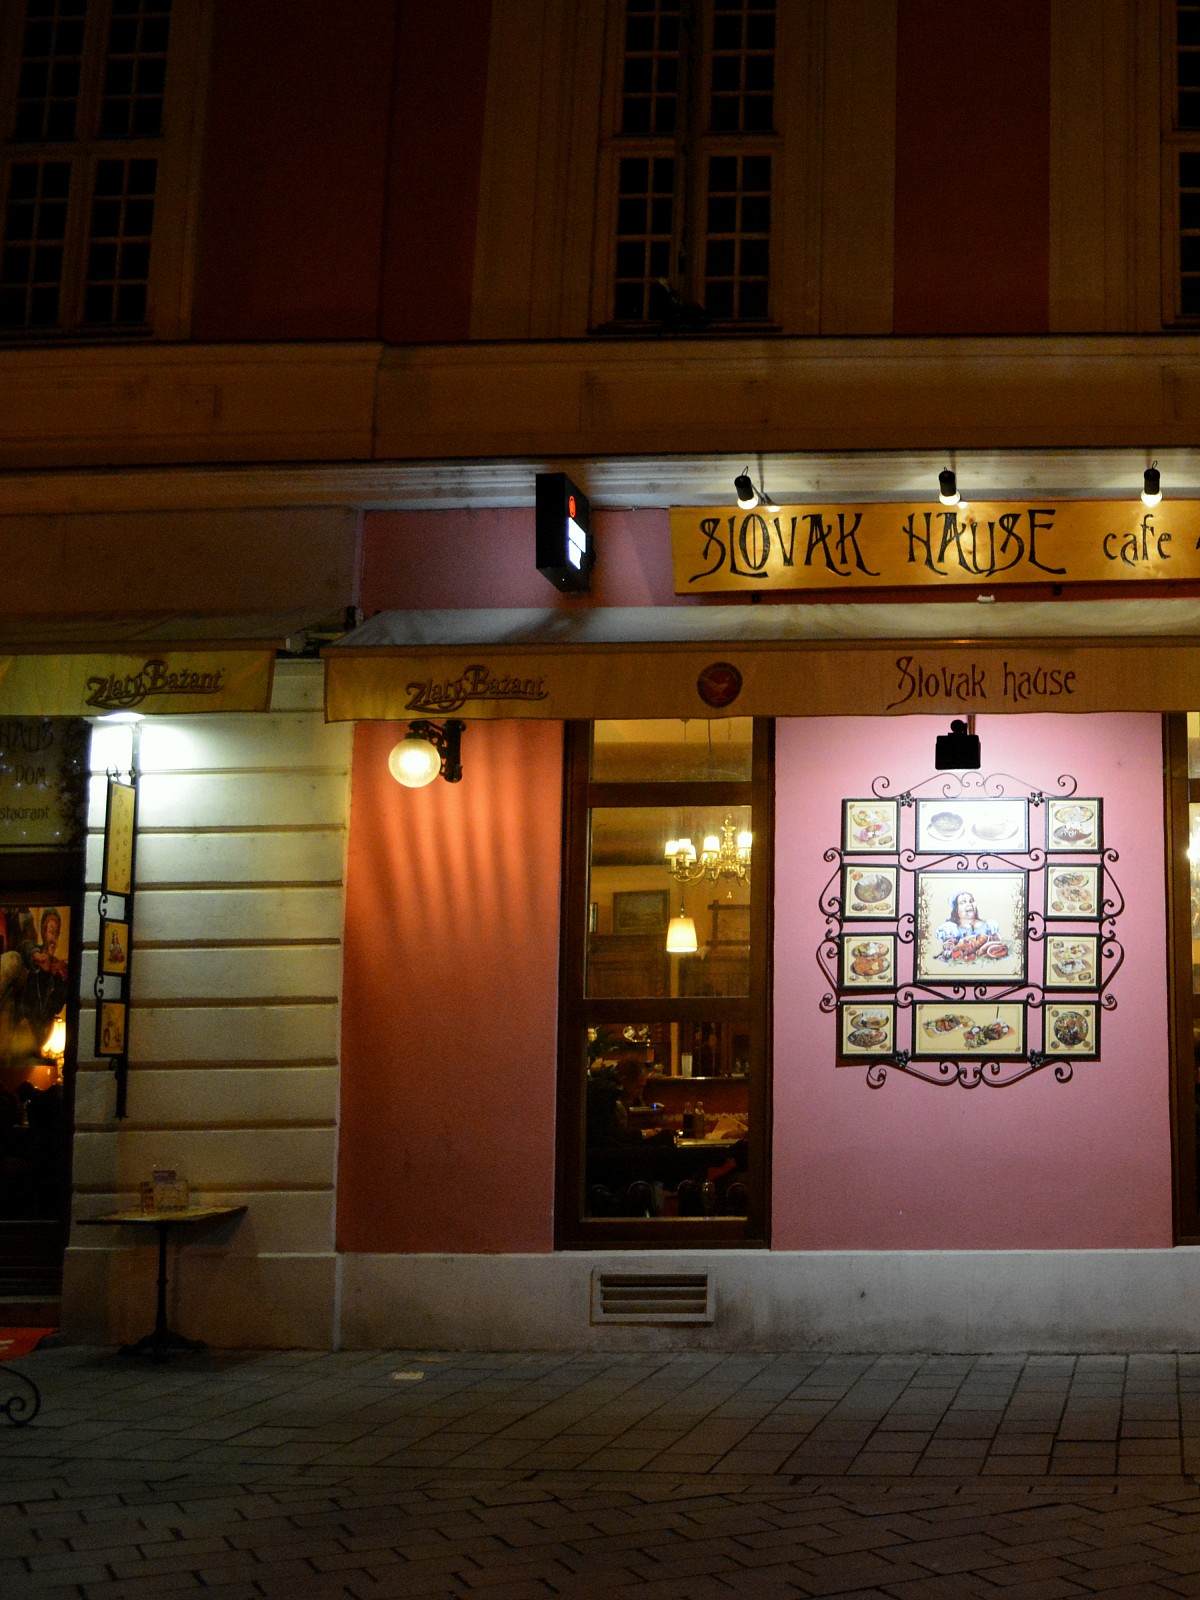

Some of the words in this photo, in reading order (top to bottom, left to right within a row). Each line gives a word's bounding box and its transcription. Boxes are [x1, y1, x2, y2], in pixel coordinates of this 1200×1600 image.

[689, 513, 880, 583] SLOVAK
[902, 509, 1067, 578] HAUSE
[1102, 513, 1172, 567] cafe
[886, 656, 987, 710] Slovak
[1003, 661, 1076, 702] hause
